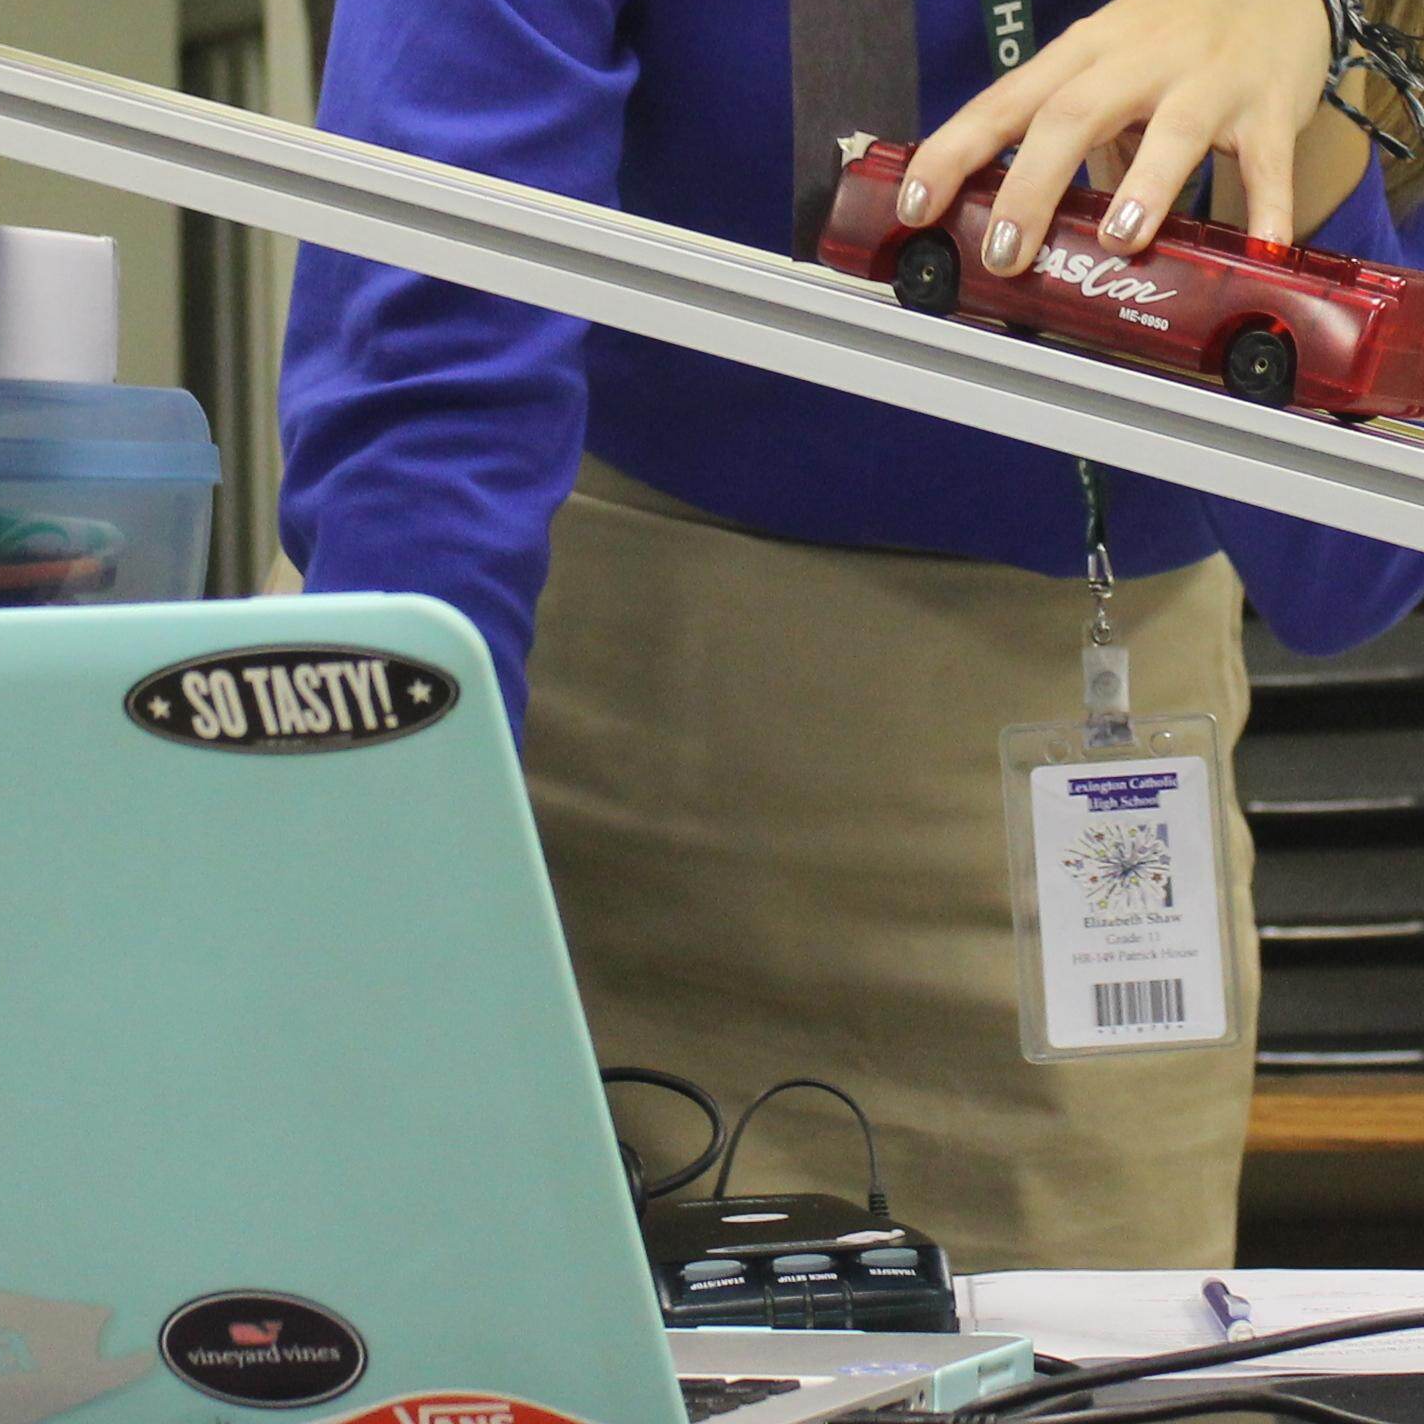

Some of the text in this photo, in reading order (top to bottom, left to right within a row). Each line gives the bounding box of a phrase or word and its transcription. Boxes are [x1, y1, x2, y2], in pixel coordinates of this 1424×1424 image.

[1118, 306, 1170, 332] ME-6950
[182, 659, 399, 739] SO TASTY!
[1128, 775, 1178, 790] Catholic
[777, 1273, 807, 1284] SETUP
[186, 1342, 341, 1368] vineyard vines
